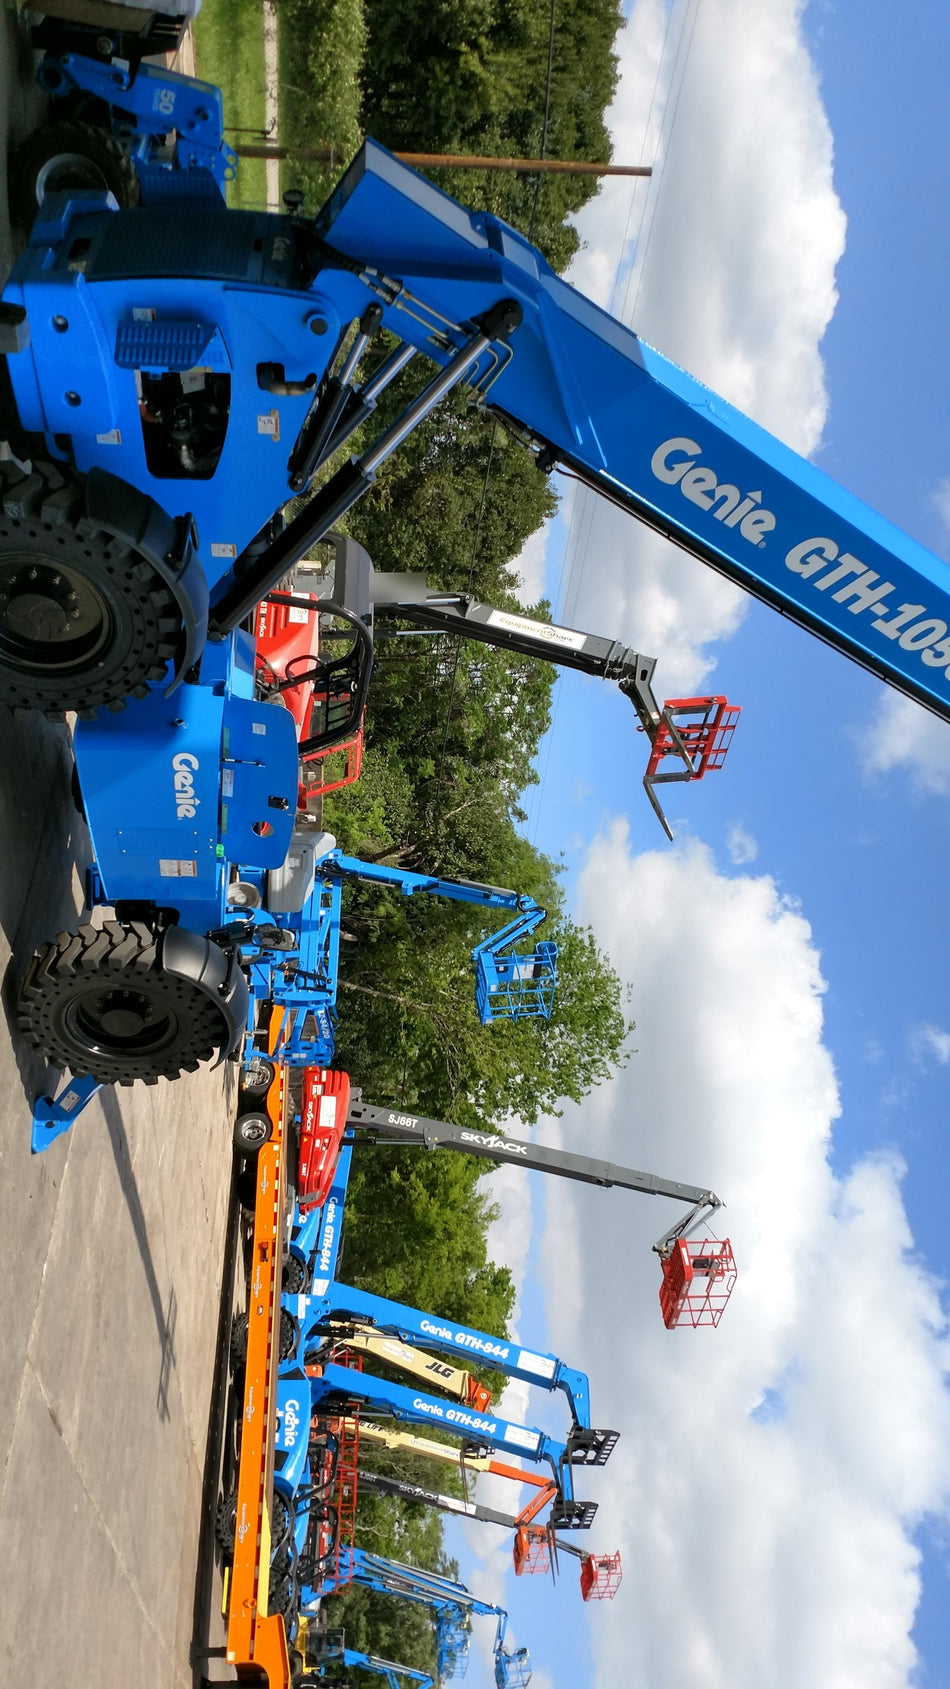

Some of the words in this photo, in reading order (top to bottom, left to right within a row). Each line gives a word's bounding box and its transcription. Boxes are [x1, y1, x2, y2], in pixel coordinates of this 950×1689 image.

[159, 89, 176, 114] 50
[785, 537, 950, 680] GTH-105
[305, 1101, 314, 1132] SKYJACK
[388, 1114, 418, 1128] SJ66T
[461, 1132, 528, 1155] SKYJACK
[325, 1196, 338, 1224] Genie
[319, 1225, 334, 1271] GTH-844
[420, 1320, 452, 1340] Genie
[454, 1332, 509, 1359] GTH-844
[425, 1361, 455, 1378] JLG
[284, 1400, 300, 1447] Genie
[413, 1398, 444, 1417] Genie
[445, 1409, 497, 1433] GTH-844
